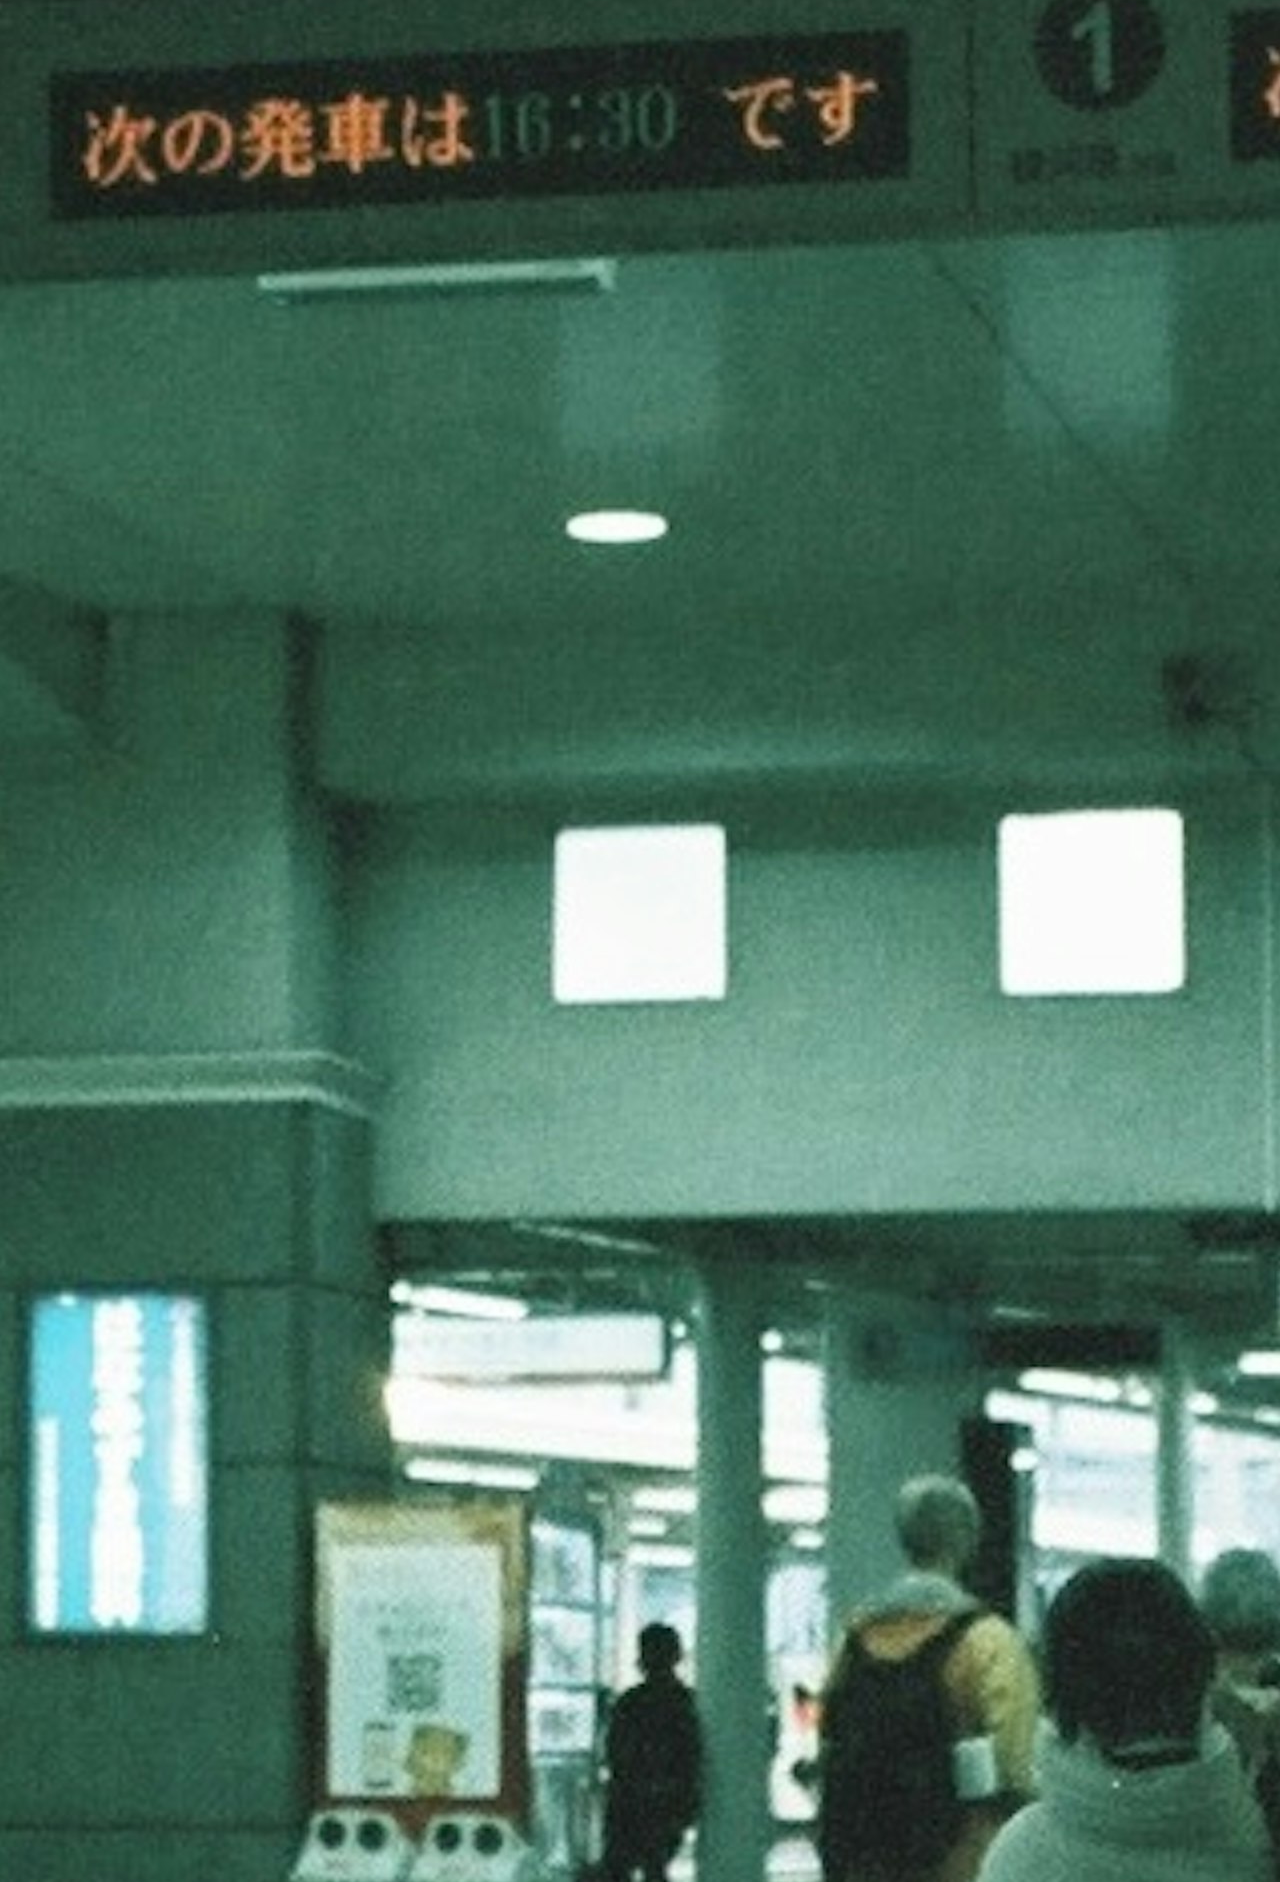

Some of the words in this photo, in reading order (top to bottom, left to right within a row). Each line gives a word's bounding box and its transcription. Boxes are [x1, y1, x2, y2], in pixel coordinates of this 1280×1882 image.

[1070, 0, 1114, 95] 1
[84, 92, 475, 185] 次の発車は
[722, 71, 878, 151] です
